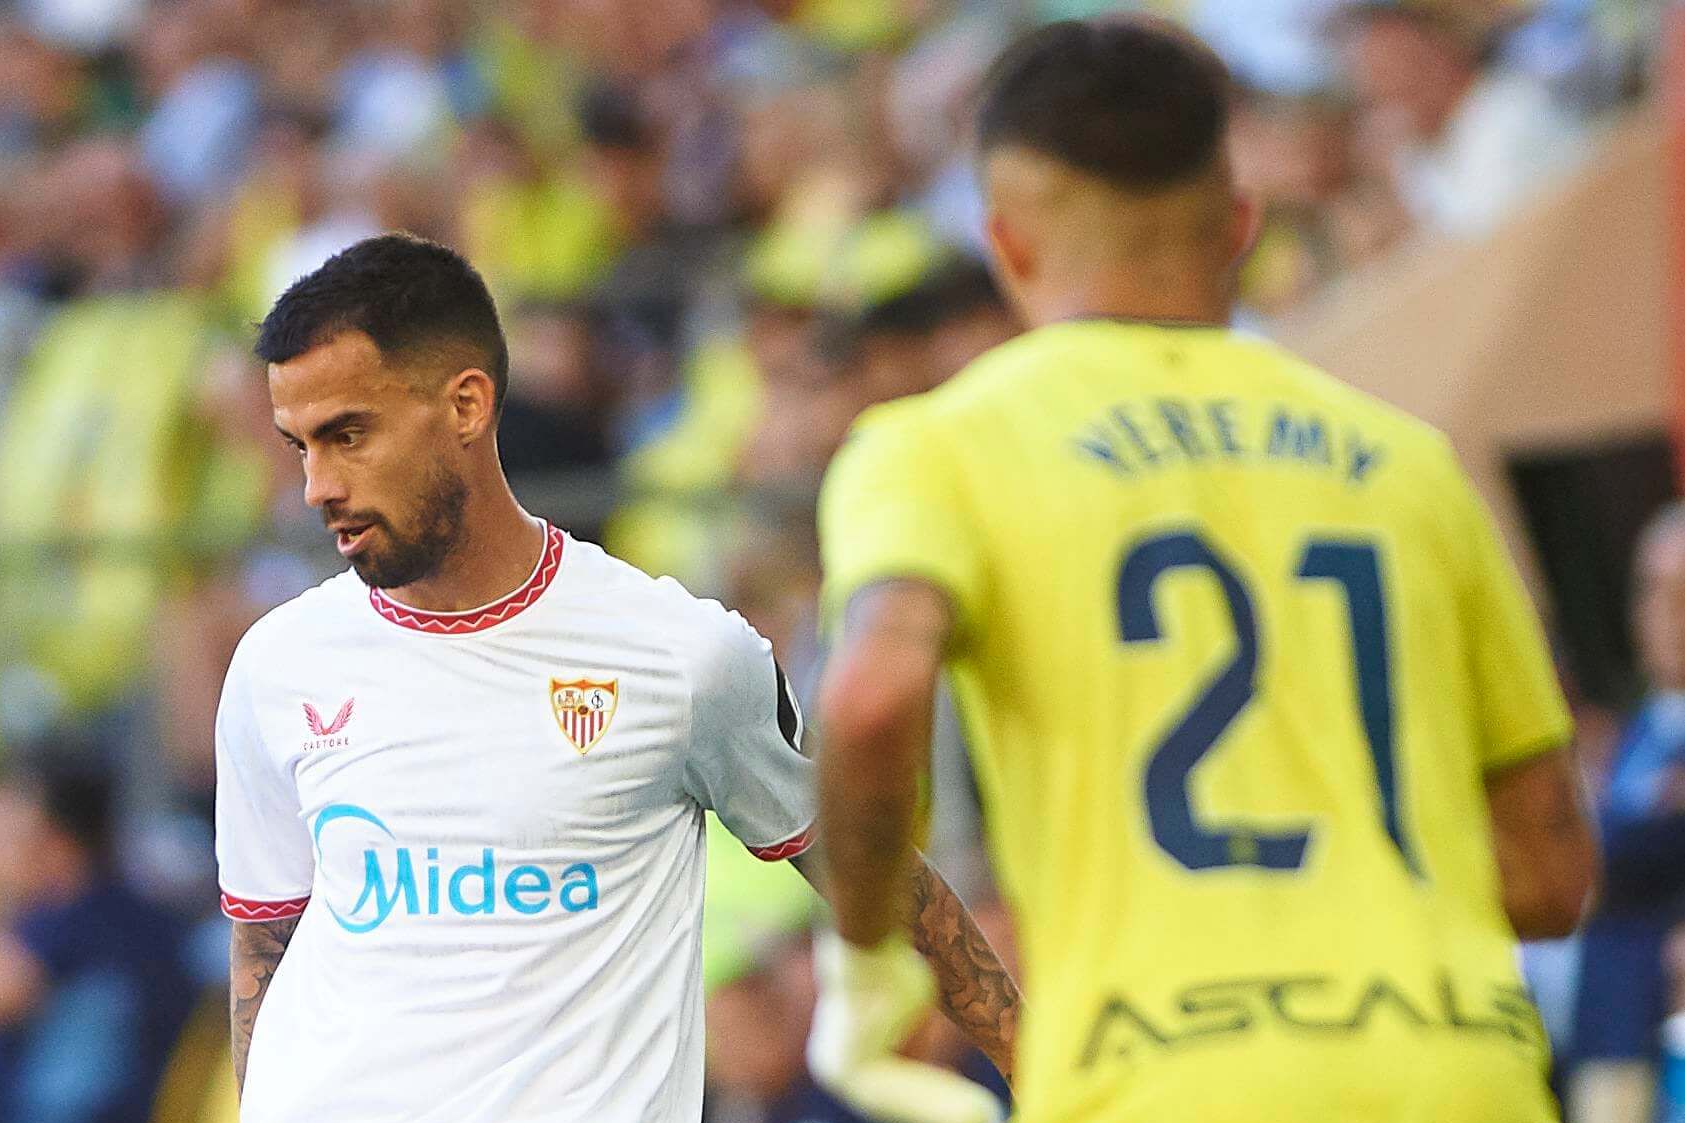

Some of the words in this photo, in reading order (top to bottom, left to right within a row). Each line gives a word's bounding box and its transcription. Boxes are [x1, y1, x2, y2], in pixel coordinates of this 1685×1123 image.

[1078, 398, 1382, 482] YEREMY
[1117, 530, 1424, 882] 21
[325, 847, 599, 933] Midea
